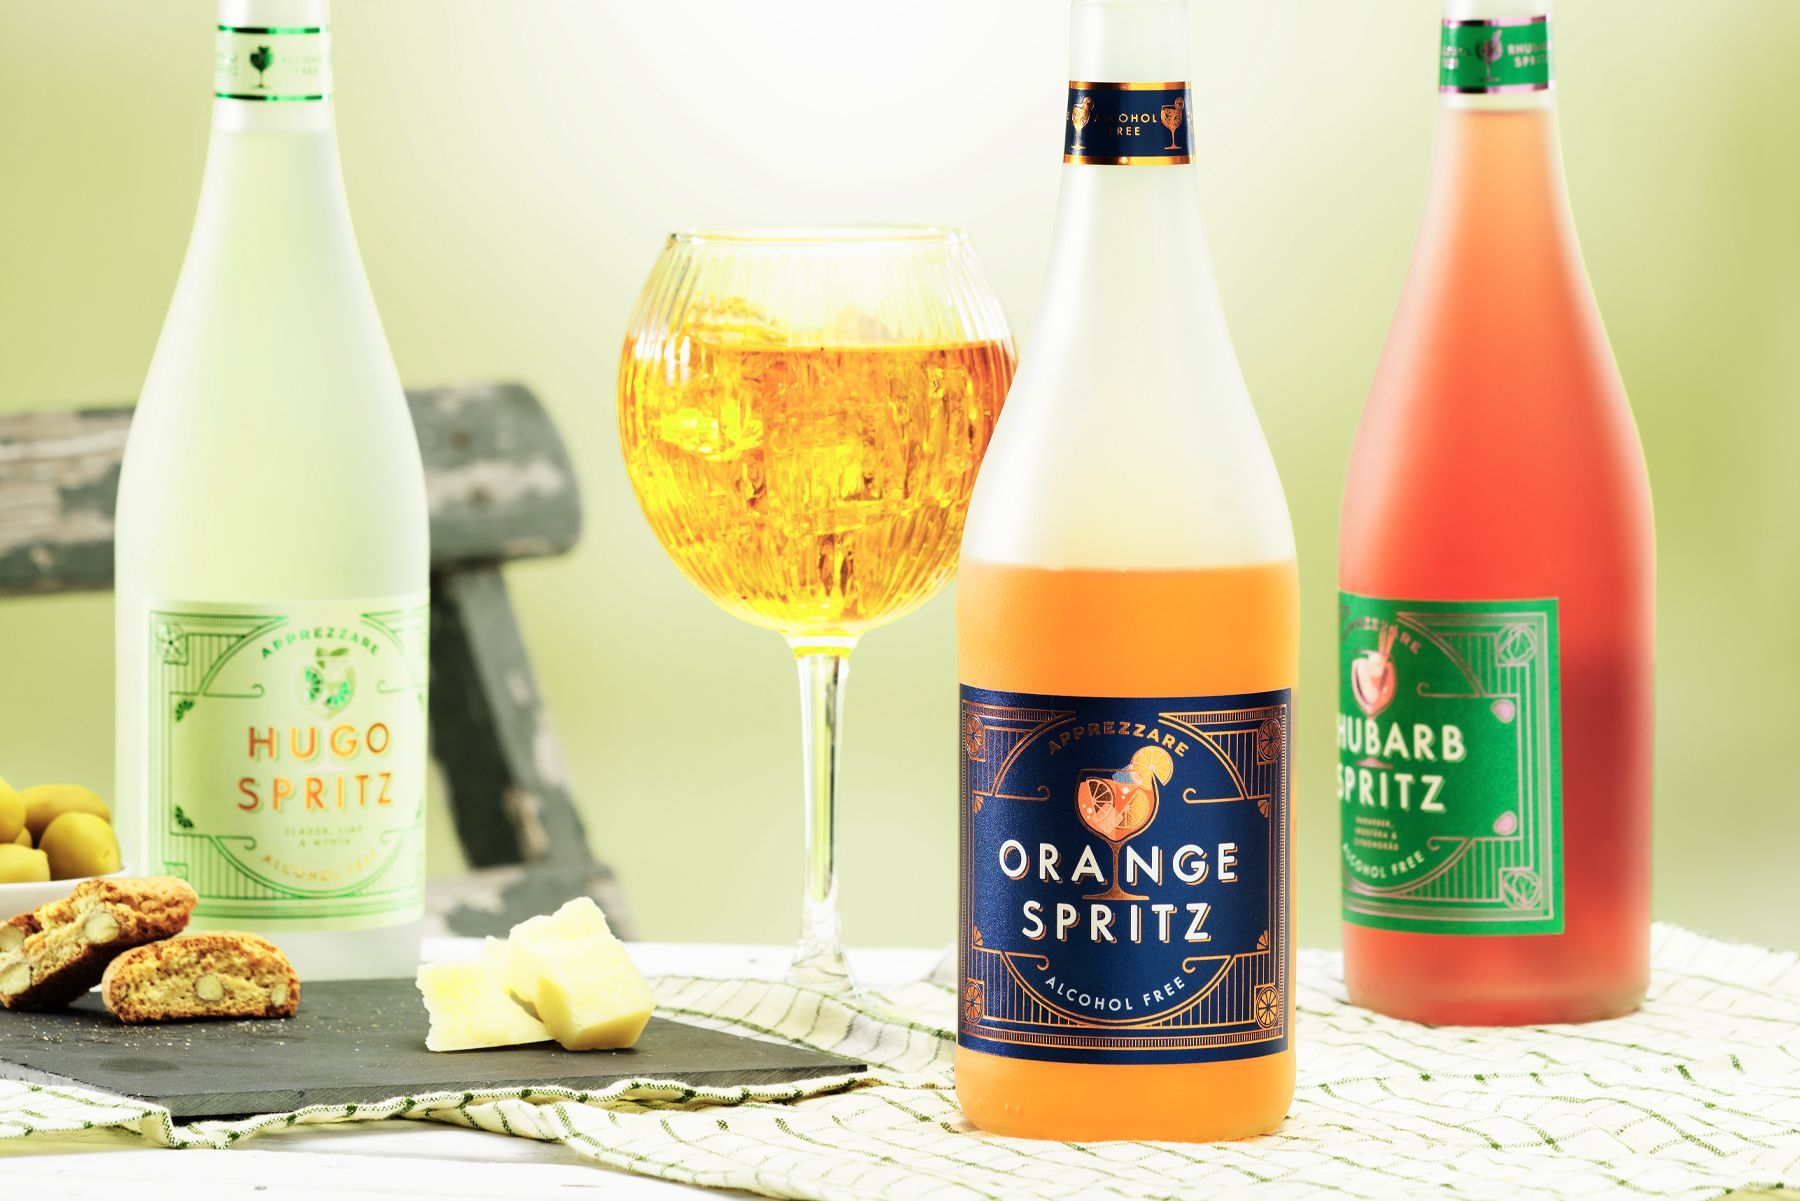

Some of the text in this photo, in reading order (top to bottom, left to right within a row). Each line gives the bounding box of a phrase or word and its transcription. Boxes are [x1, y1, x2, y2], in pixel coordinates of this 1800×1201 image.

[1110, 126, 1141, 136] REE
[262, 627, 379, 659] APPREZZARE
[248, 722, 391, 761] HUGO
[1049, 721, 1189, 757] APPREZZARE
[1338, 714, 1467, 762] HUBARB
[237, 772, 393, 812] SPRITZ
[998, 840, 1239, 885] ORANGE
[1021, 901, 1212, 944] SPRITZ
[1045, 976, 1185, 1011] ALCOHOL FREE
